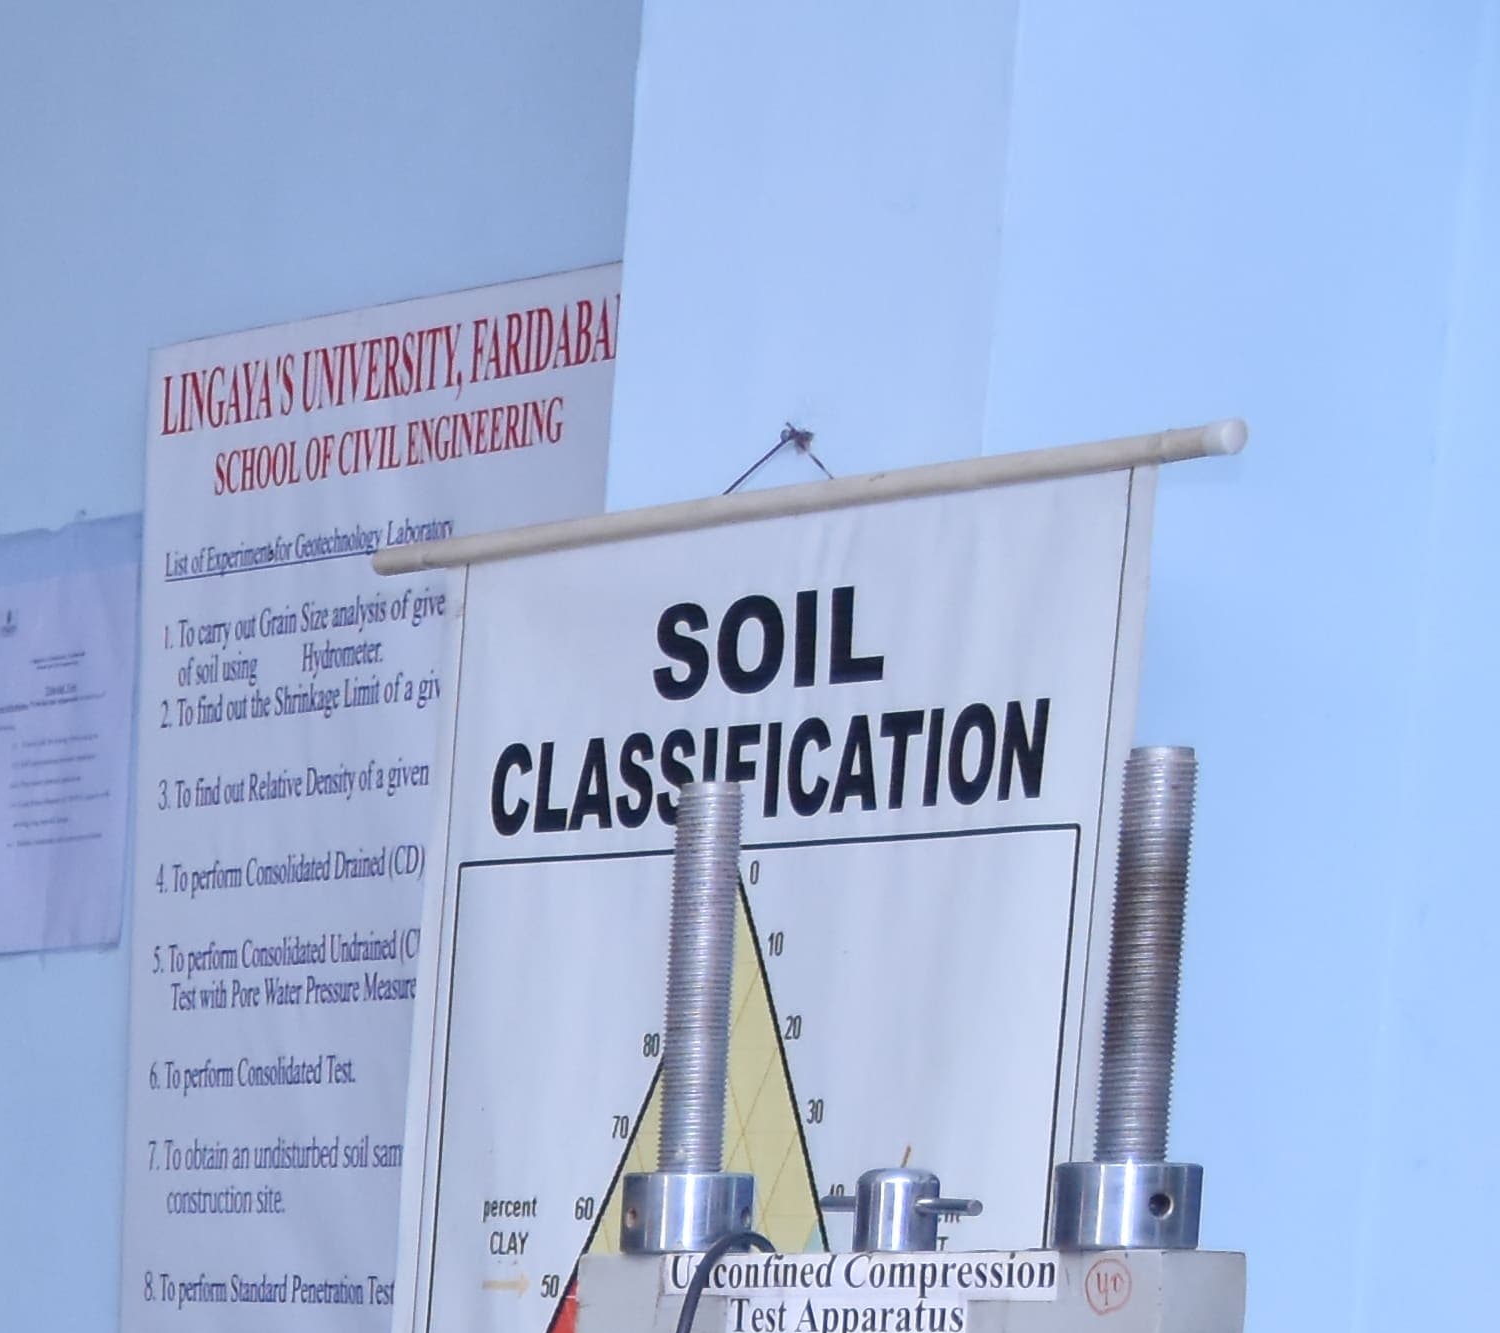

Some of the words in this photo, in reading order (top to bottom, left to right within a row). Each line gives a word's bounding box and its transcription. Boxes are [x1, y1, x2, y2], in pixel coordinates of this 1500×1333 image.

[160, 354, 295, 437] LINGAYA'S
[303, 324, 465, 413] UNIVERSITY,
[469, 293, 620, 385] FARIDABA
[214, 440, 300, 496] SCHOOL
[306, 434, 335, 481] OF
[338, 424, 401, 476] CIVIL
[407, 397, 565, 466] ENGINEERING
[178, 619, 195, 648] To
[199, 620, 230, 650] carry
[235, 616, 256, 640] out
[259, 606, 297, 638] Grain
[301, 601, 328, 633] Size
[332, 593, 386, 633] analysis
[391, 589, 412, 621] of
[653, 585, 885, 700] SOIL
[178, 654, 192, 687] of
[195, 654, 218, 685] soil
[223, 650, 258, 686] using
[302, 639, 384, 678] Hydrometer.
[158, 779, 171, 811] 3.
[175, 779, 192, 809] To
[195, 776, 221, 808] find
[224, 778, 246, 804] out
[248, 768, 301, 803] Relative
[306, 759, 357, 801] Density
[358, 759, 375, 791] of
[375, 771, 385, 789] a
[386, 757, 429, 796] given
[491, 697, 1051, 837] CLASSIFICATION
[172, 864, 188, 893] To
[191, 859, 242, 899] perform
[246, 850, 331, 888] Consolidated
[334, 847, 386, 879] Drained
[387, 845, 425, 881] (CD)
[749, 860, 760, 884] 0
[767, 931, 784, 957] 10
[171, 982, 197, 1012] Test
[199, 980, 228, 1010] with
[231, 979, 260, 1009] Pore
[263, 977, 303, 1007] Water
[304, 975, 361, 1004] Pressure
[643, 1033, 660, 1057] 80
[784, 1015, 802, 1040] 20
[612, 1115, 629, 1139] 70
[806, 1099, 824, 1124] 30
[164, 1139, 182, 1171] To
[185, 1138, 228, 1170] obtain
[232, 1145, 249, 1170] an
[253, 1137, 338, 1170] undisturbed
[341, 1135, 369, 1168] soil
[166, 1185, 252, 1214] construction
[256, 1185, 285, 1214] site.
[483, 1195, 537, 1222] percent
[575, 1197, 595, 1221] 60
[489, 1231, 529, 1255] CLAY
[160, 1273, 176, 1303] To
[178, 1272, 227, 1311] perform
[230, 1274, 288, 1304] Standard
[291, 1274, 364, 1305] Penetration
[367, 1275, 395, 1306] Test
[541, 1274, 560, 1298] 50
[671, 1253, 838, 1290] Uconfined
[844, 1252, 1056, 1299] Compression
[729, 1298, 788, 1333] Test
